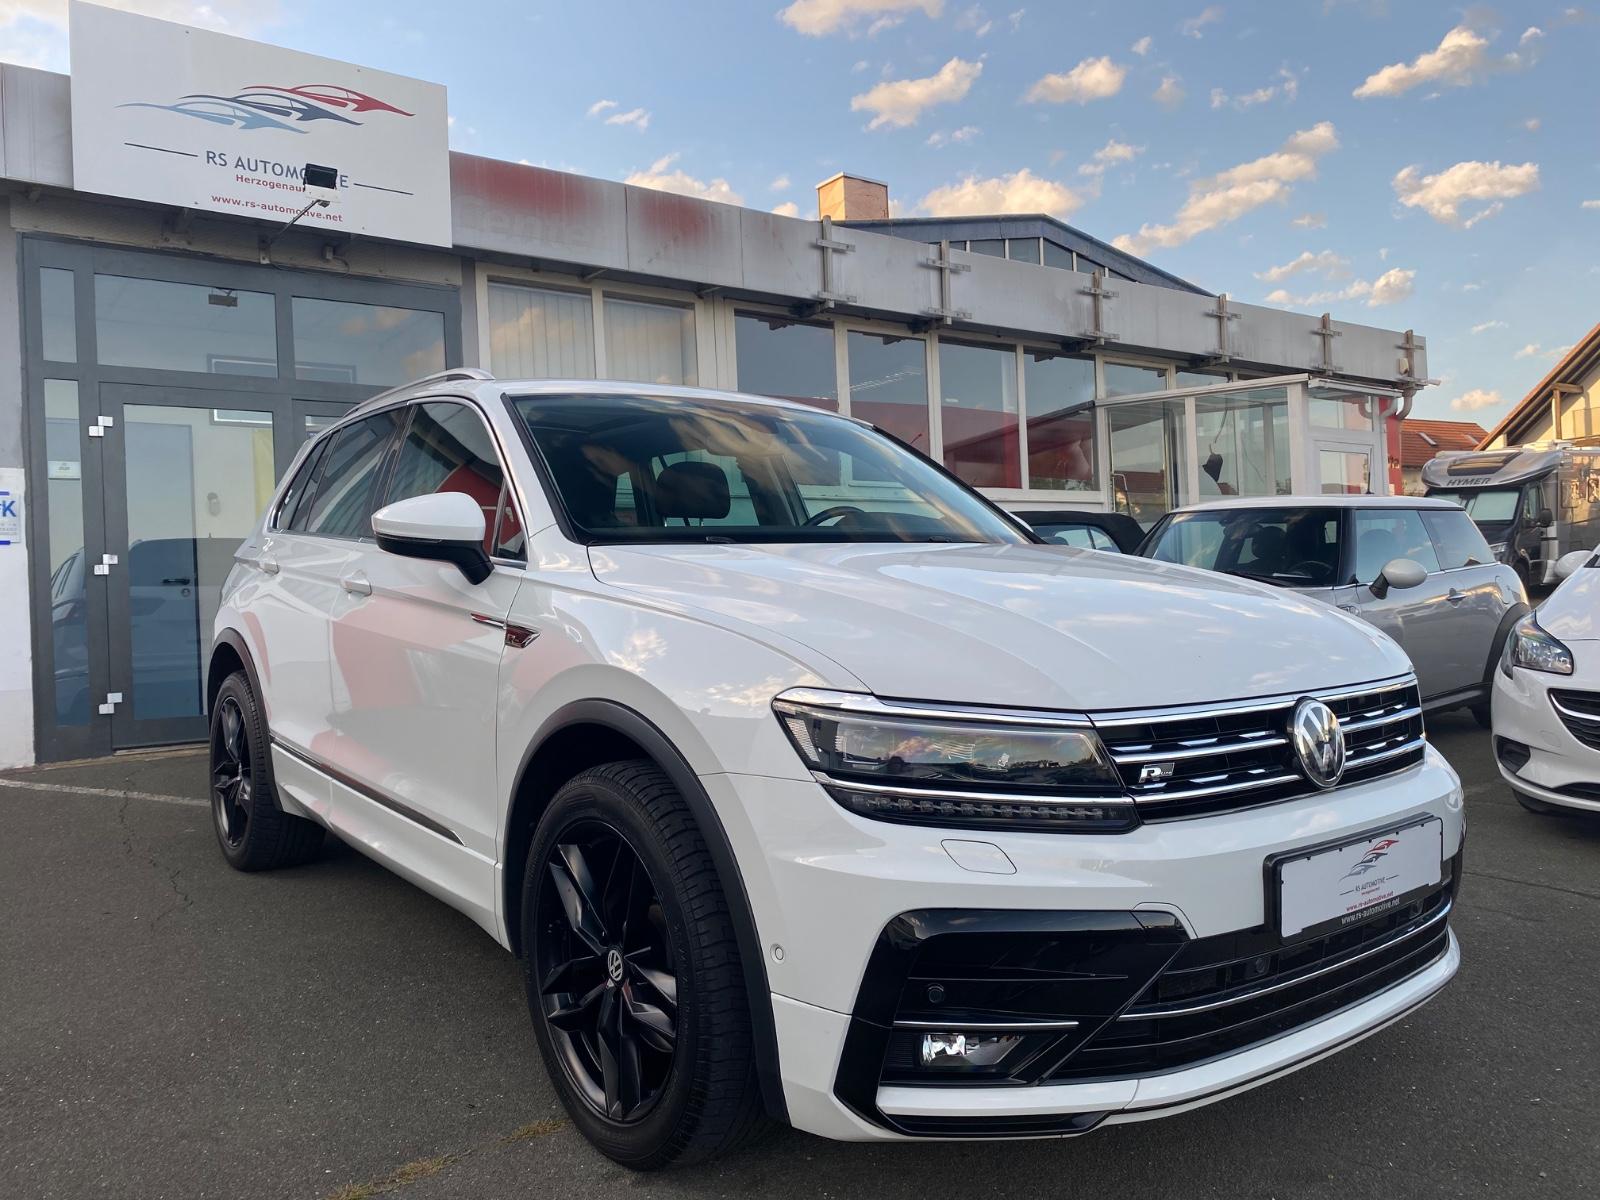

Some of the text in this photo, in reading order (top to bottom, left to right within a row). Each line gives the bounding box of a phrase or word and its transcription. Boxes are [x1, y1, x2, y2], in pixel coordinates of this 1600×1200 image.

[205, 150, 349, 188] RS AUTOME
[235, 173, 305, 193] Herzogenau
[1446, 477, 1491, 487] HYMER
[0, 500, 17, 518] K
[1341, 897, 1400, 925] www.rs-automotive.net
[1345, 890, 1394, 912] www.rs-automotive.net
